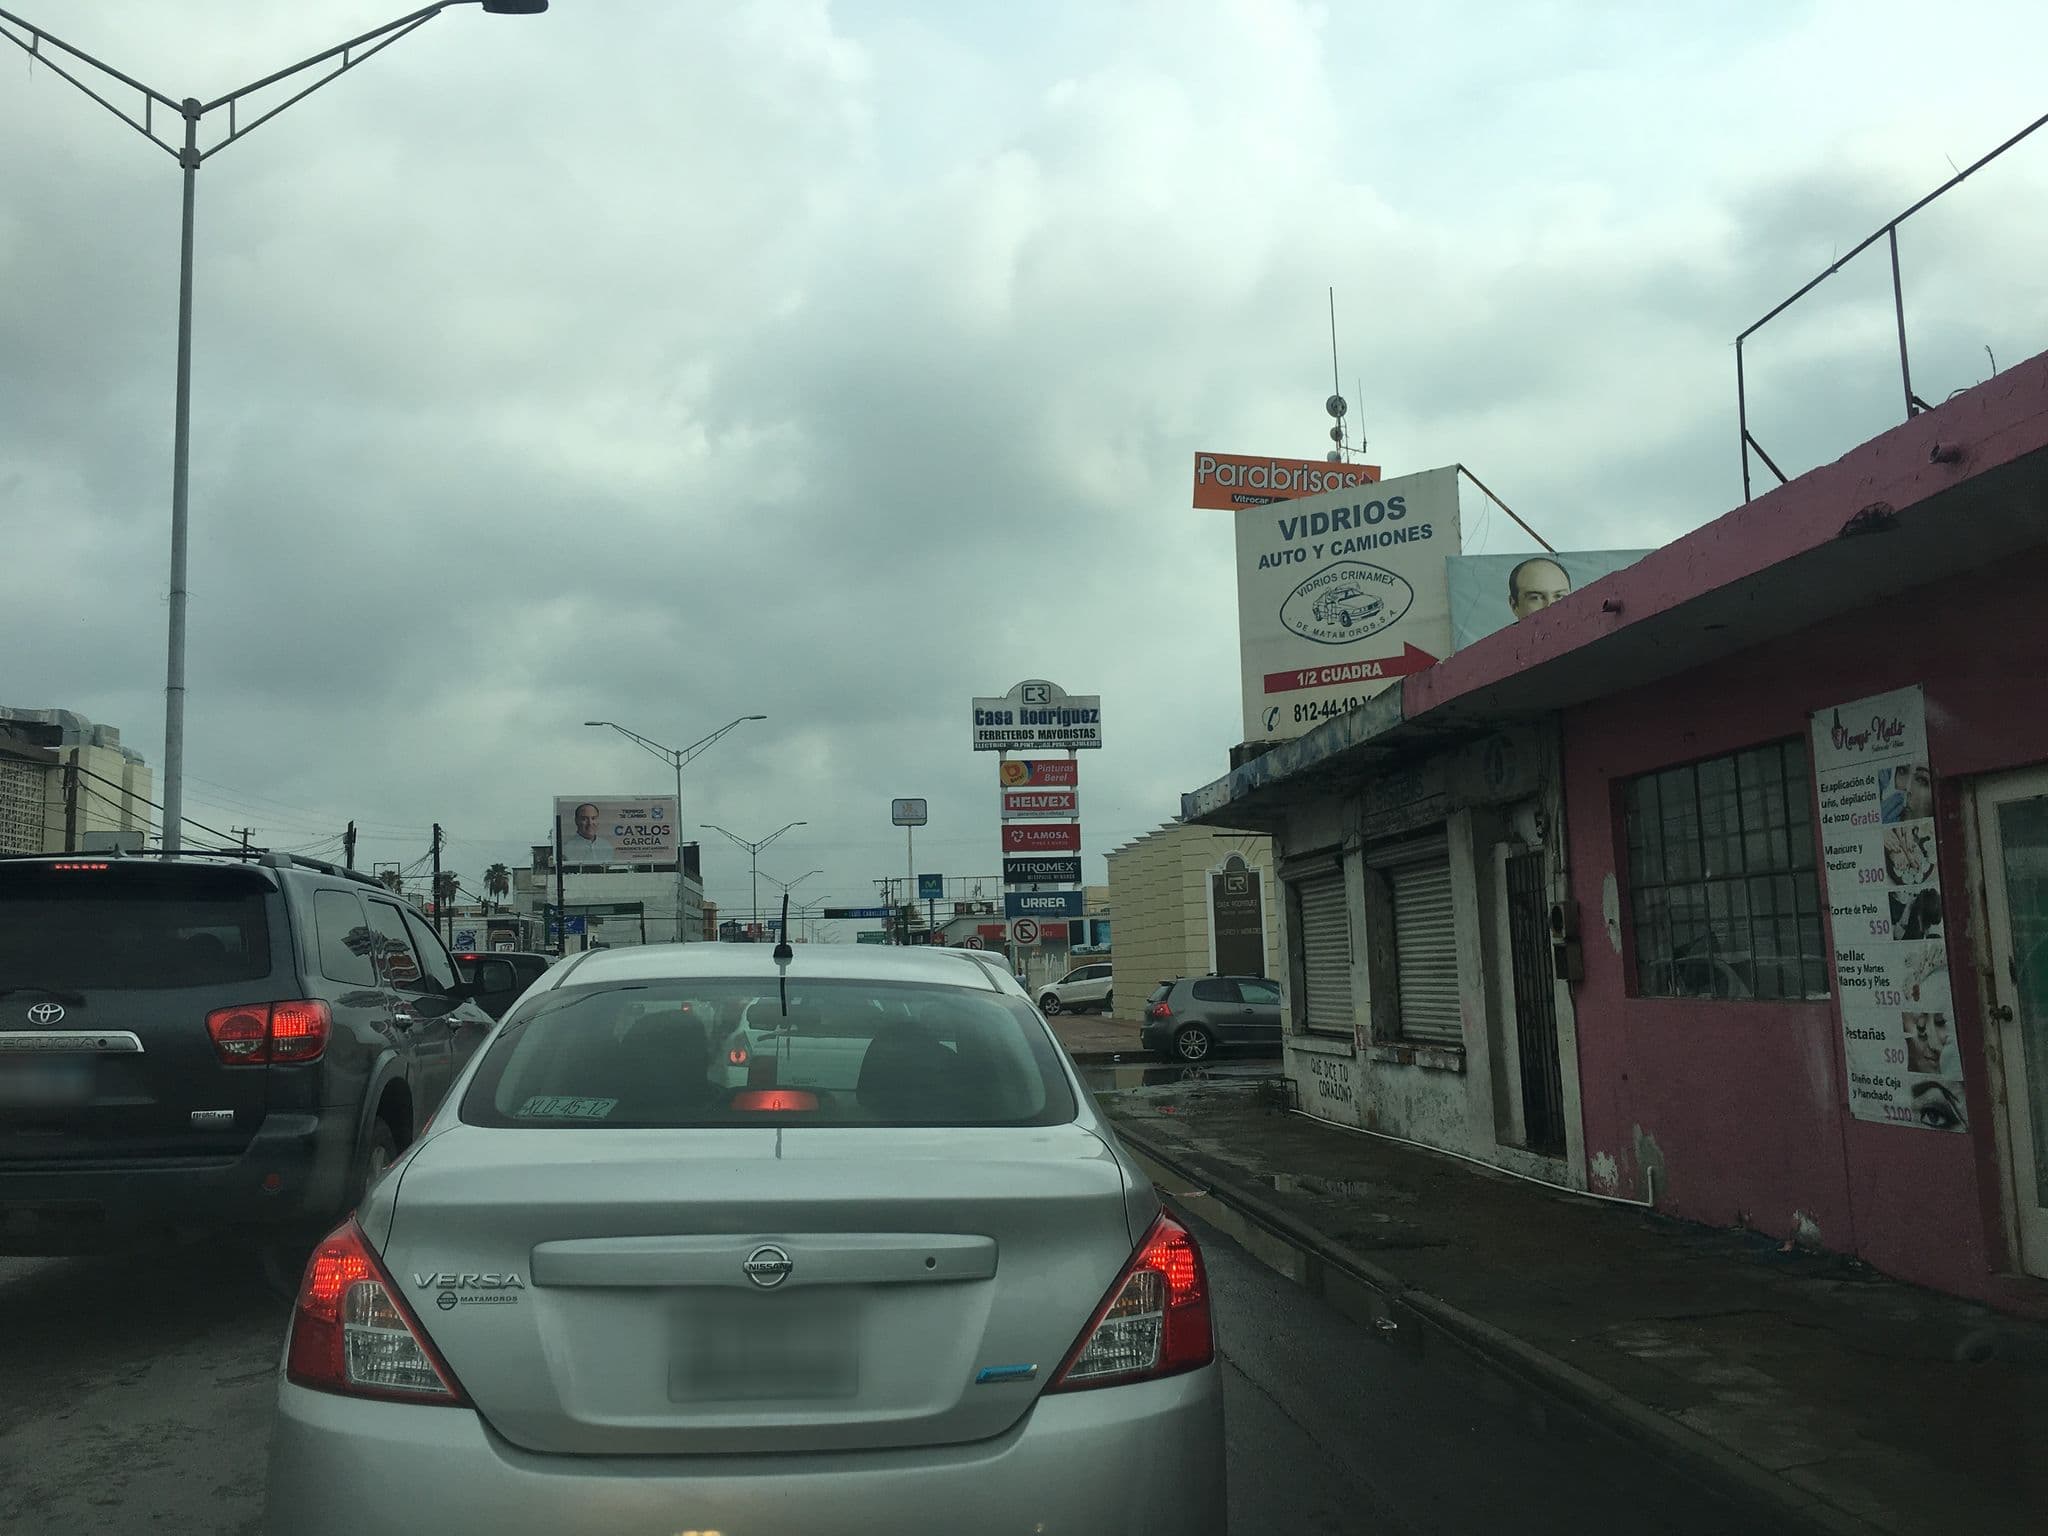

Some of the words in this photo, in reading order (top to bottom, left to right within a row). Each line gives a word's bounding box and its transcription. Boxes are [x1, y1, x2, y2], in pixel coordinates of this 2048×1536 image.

[1198, 456, 1359, 494] Parabrisas
[1278, 496, 1407, 541] VIDRIOS
[1258, 548, 1307, 570] AUTO
[1312, 544, 1325, 559] Y
[1331, 523, 1433, 556] CAMIONES
[1296, 573, 1338, 598] VIDRIOS
[1340, 570, 1396, 587] CRINAMEX
[1296, 621, 1309, 632] DE
[1297, 671, 1317, 686] 1/2
[1321, 662, 1383, 682] CUADRA
[975, 707, 1013, 726] Casa
[979, 729, 1034, 740] FERRETEROS
[1038, 728, 1096, 740] MAYORISTAS
[1865, 776, 1875, 785] de
[1009, 795, 1071, 808] HELVEX
[1851, 810, 1880, 826] Gratis
[614, 825, 670, 836] CARLOS
[1027, 831, 1069, 840] LAMOSA
[622, 836, 661, 846] GARCÍA
[1007, 862, 1074, 872] VITROMEX
[1858, 868, 1885, 884] $300
[1020, 897, 1066, 908] URREA
[1862, 904, 1878, 914] Pelo
[1869, 919, 1890, 935] $50
[1874, 990, 1901, 1006] $150
[1884, 1047, 1905, 1064] $80
[1872, 1076, 1884, 1087] de
[748, 1263, 786, 1271] NISSAN
[413, 1272, 525, 1289] VERSA
